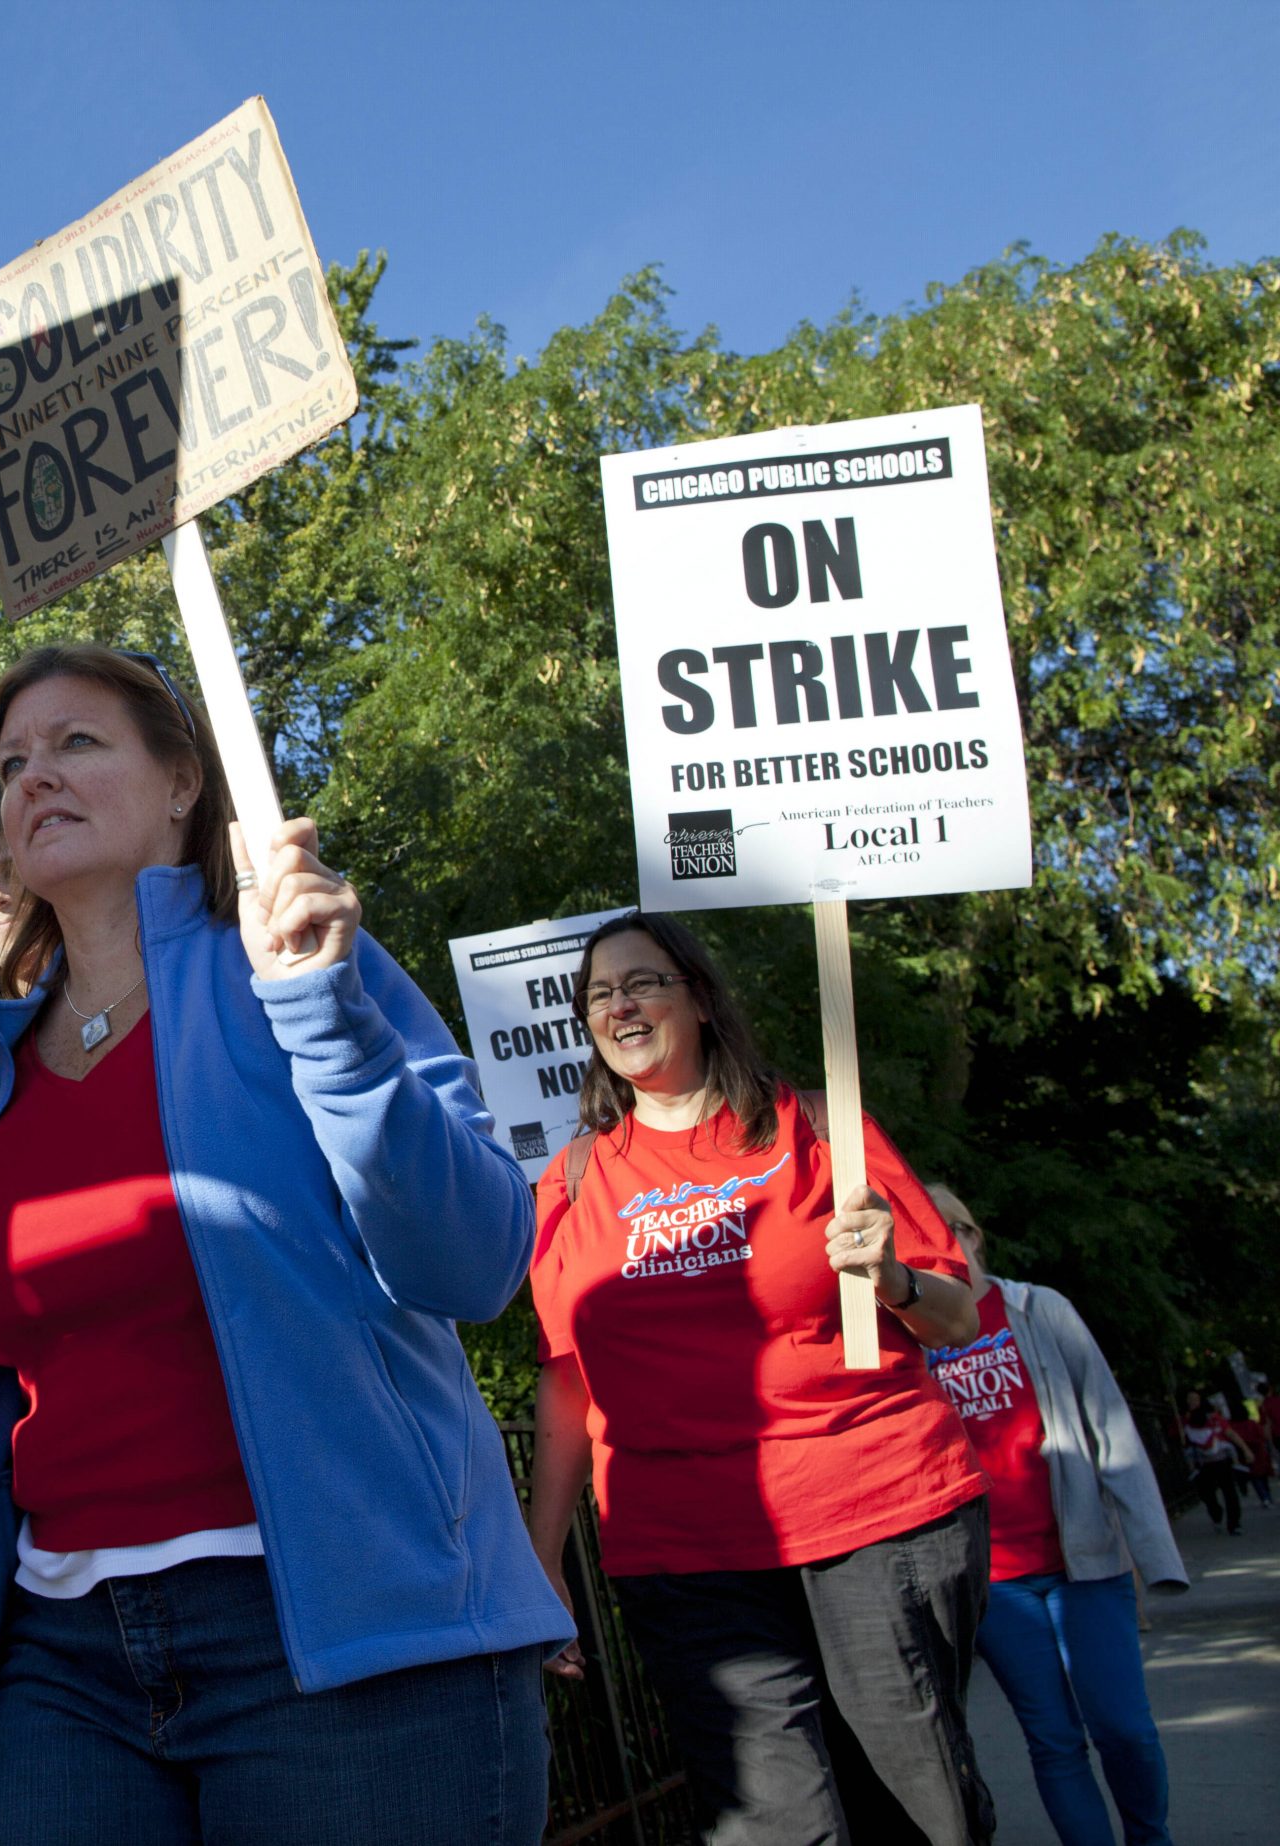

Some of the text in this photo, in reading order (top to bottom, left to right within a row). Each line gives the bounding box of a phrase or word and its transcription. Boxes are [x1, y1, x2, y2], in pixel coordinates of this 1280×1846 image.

[13, 387, 337, 592] THERE IS AN ALTERNATIVE!
[642, 447, 943, 504] CHICAGO PUBLIC SCHOOLS
[13, 592, 40, 611] THE
[43, 560, 96, 595] WEEKEND
[136, 512, 177, 542] HUMAN
[741, 516, 863, 609] ON
[657, 624, 980, 736] STRIKE
[671, 738, 989, 793] FOR BETTER SCHOOLS
[778, 794, 994, 822] American Federation of Teachers
[671, 841, 734, 858] TEACHERS
[823, 815, 951, 851] Local 1
[673, 855, 735, 876] UNION
[857, 851, 921, 867] AFL-CIO
[474, 950, 521, 967] EDUCATORS
[521, 945, 548, 958] STAND
[547, 938, 580, 953] STRONG
[490, 1017, 593, 1062] CONTR
[537, 1061, 587, 1099] NO
[515, 1146, 548, 1160] UNION
[630, 1197, 747, 1235] TEACHERS
[625, 1213, 747, 1261] UNION
[621, 1244, 753, 1279] Clinicians
[931, 1345, 1018, 1380] EACHERS
[941, 1363, 1024, 1403] NION
